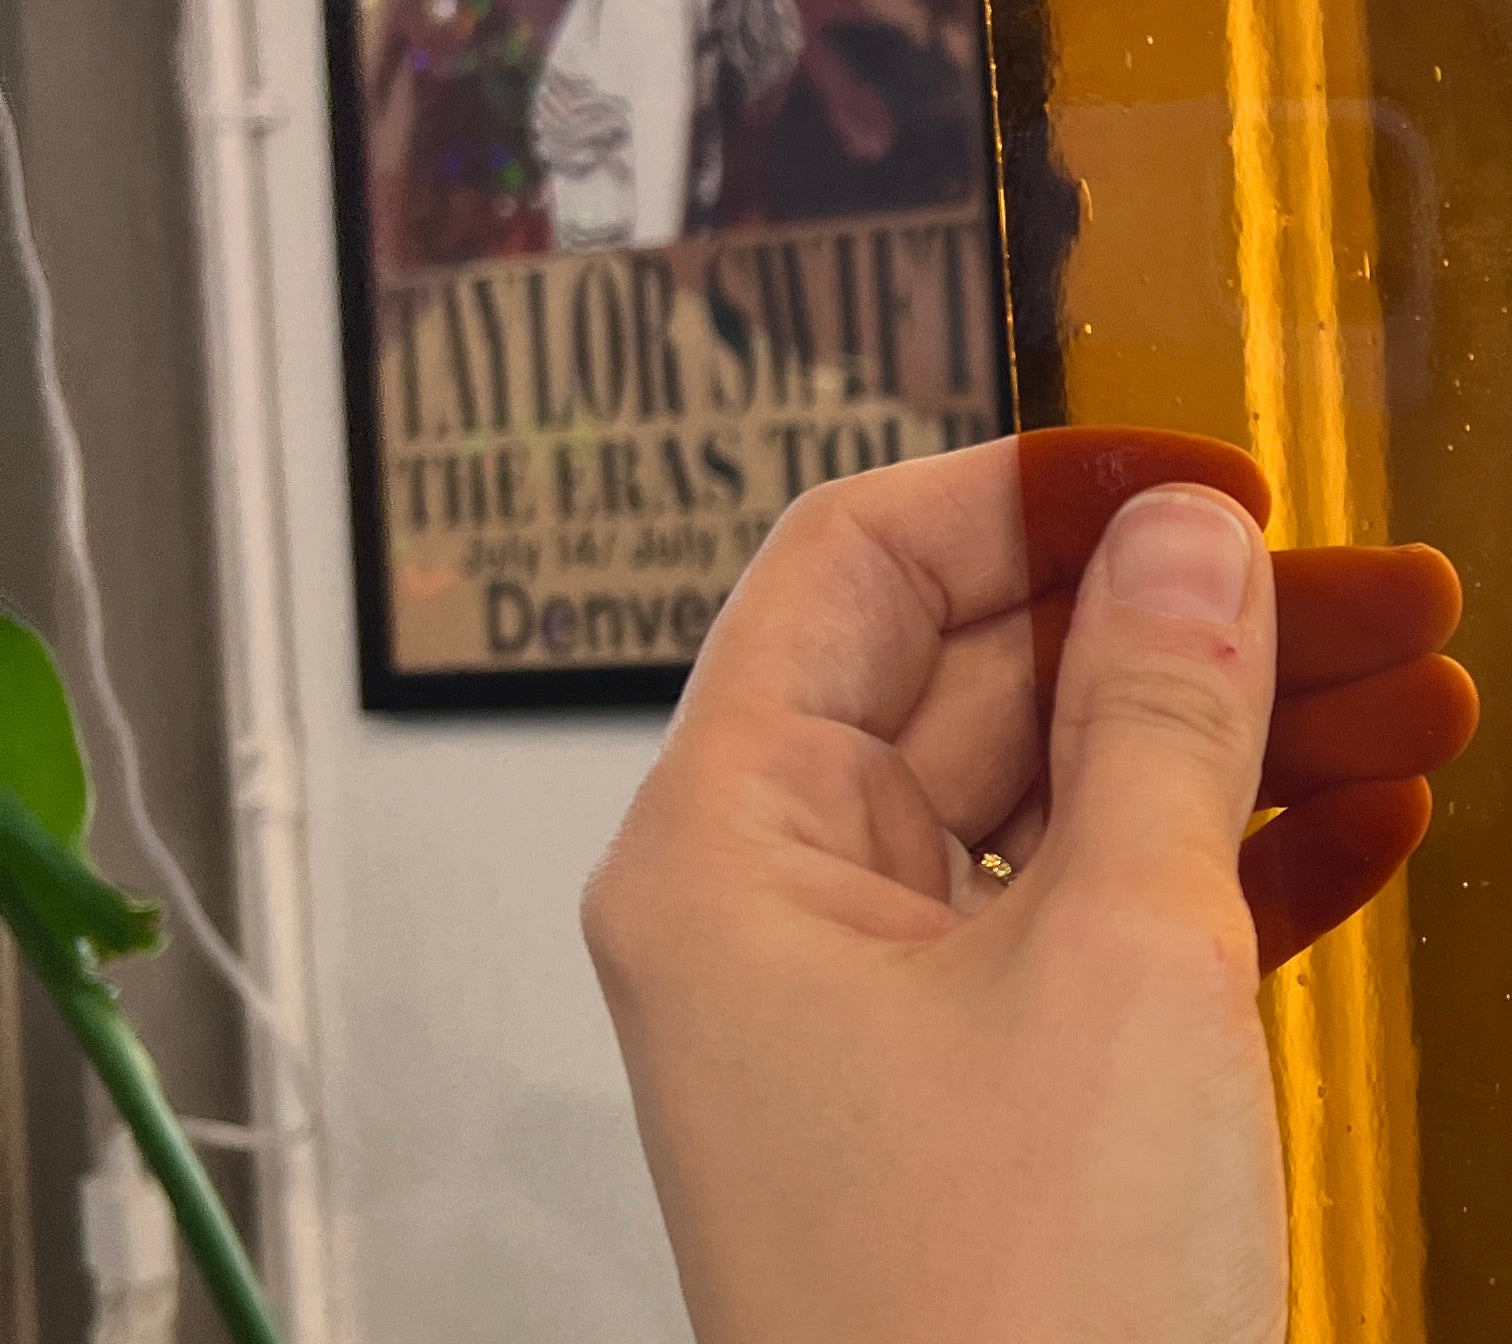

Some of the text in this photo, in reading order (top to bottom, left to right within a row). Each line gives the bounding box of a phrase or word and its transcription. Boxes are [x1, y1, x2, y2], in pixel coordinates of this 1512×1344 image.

[387, 222, 983, 437] TAYLOR SWIFT
[398, 440, 536, 533] THE
[553, 419, 743, 515] ERAS
[486, 580, 730, 655] Denve
